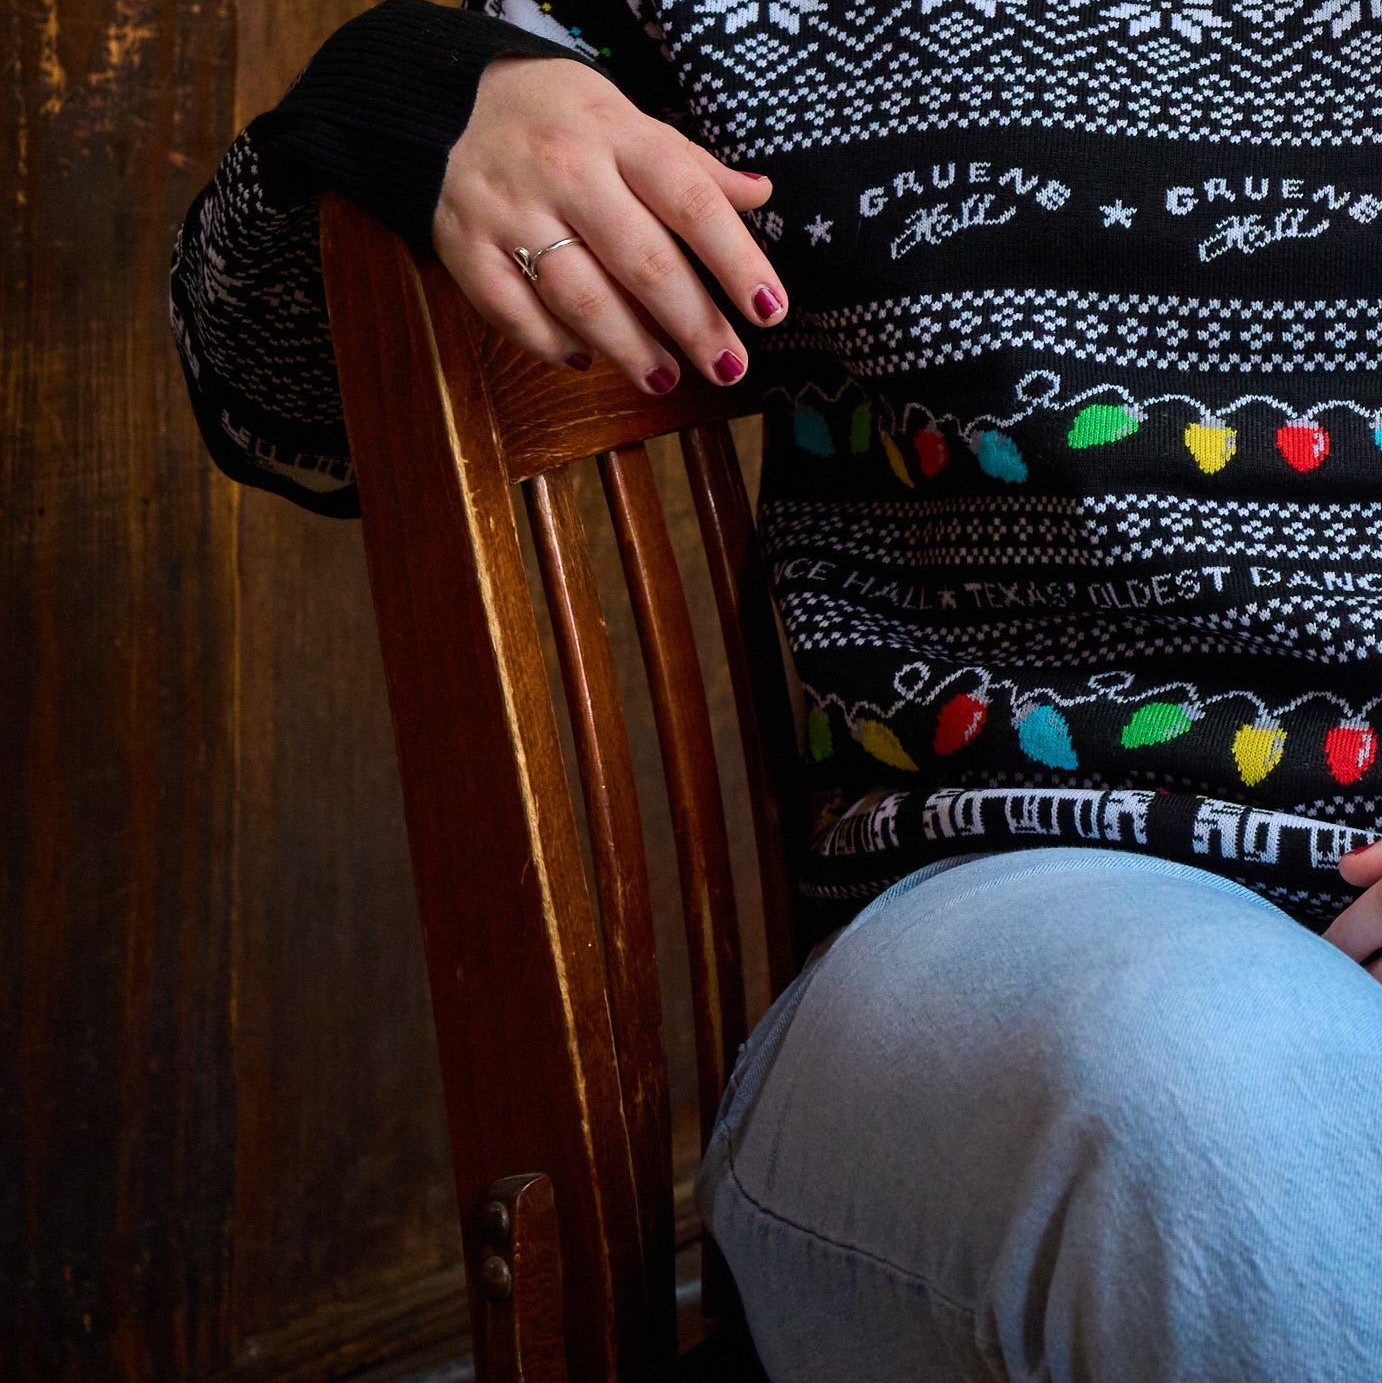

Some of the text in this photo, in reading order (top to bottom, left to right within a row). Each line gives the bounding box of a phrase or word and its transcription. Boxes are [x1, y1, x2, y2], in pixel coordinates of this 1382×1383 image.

[859, 161, 1071, 211] GRUENE
[1165, 175, 1382, 223] GRUENE
[1086, 566, 1231, 609] OLDEST
